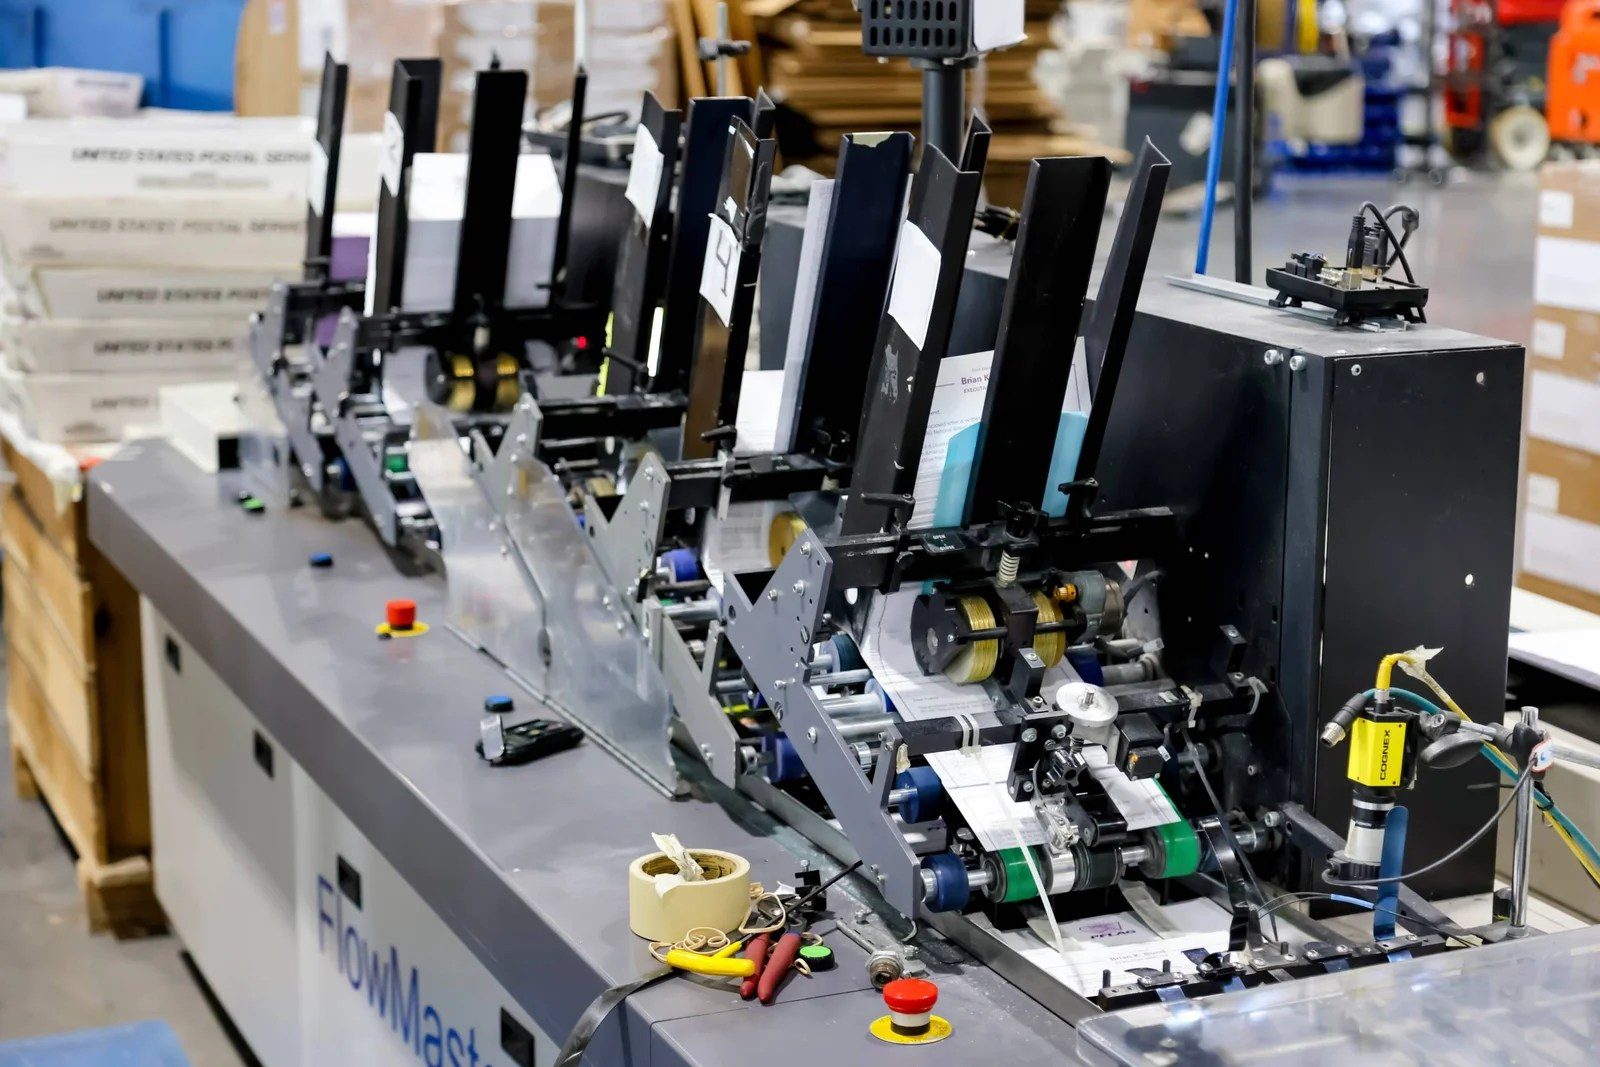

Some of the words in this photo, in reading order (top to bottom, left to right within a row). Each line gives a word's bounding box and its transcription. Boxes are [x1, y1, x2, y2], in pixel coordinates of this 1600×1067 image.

[961, 376, 983, 385] Brian
[1379, 729, 1391, 781] COGNEX
[1090, 929, 1136, 940] PFLAG
[318, 875, 493, 1067] FlowMast
